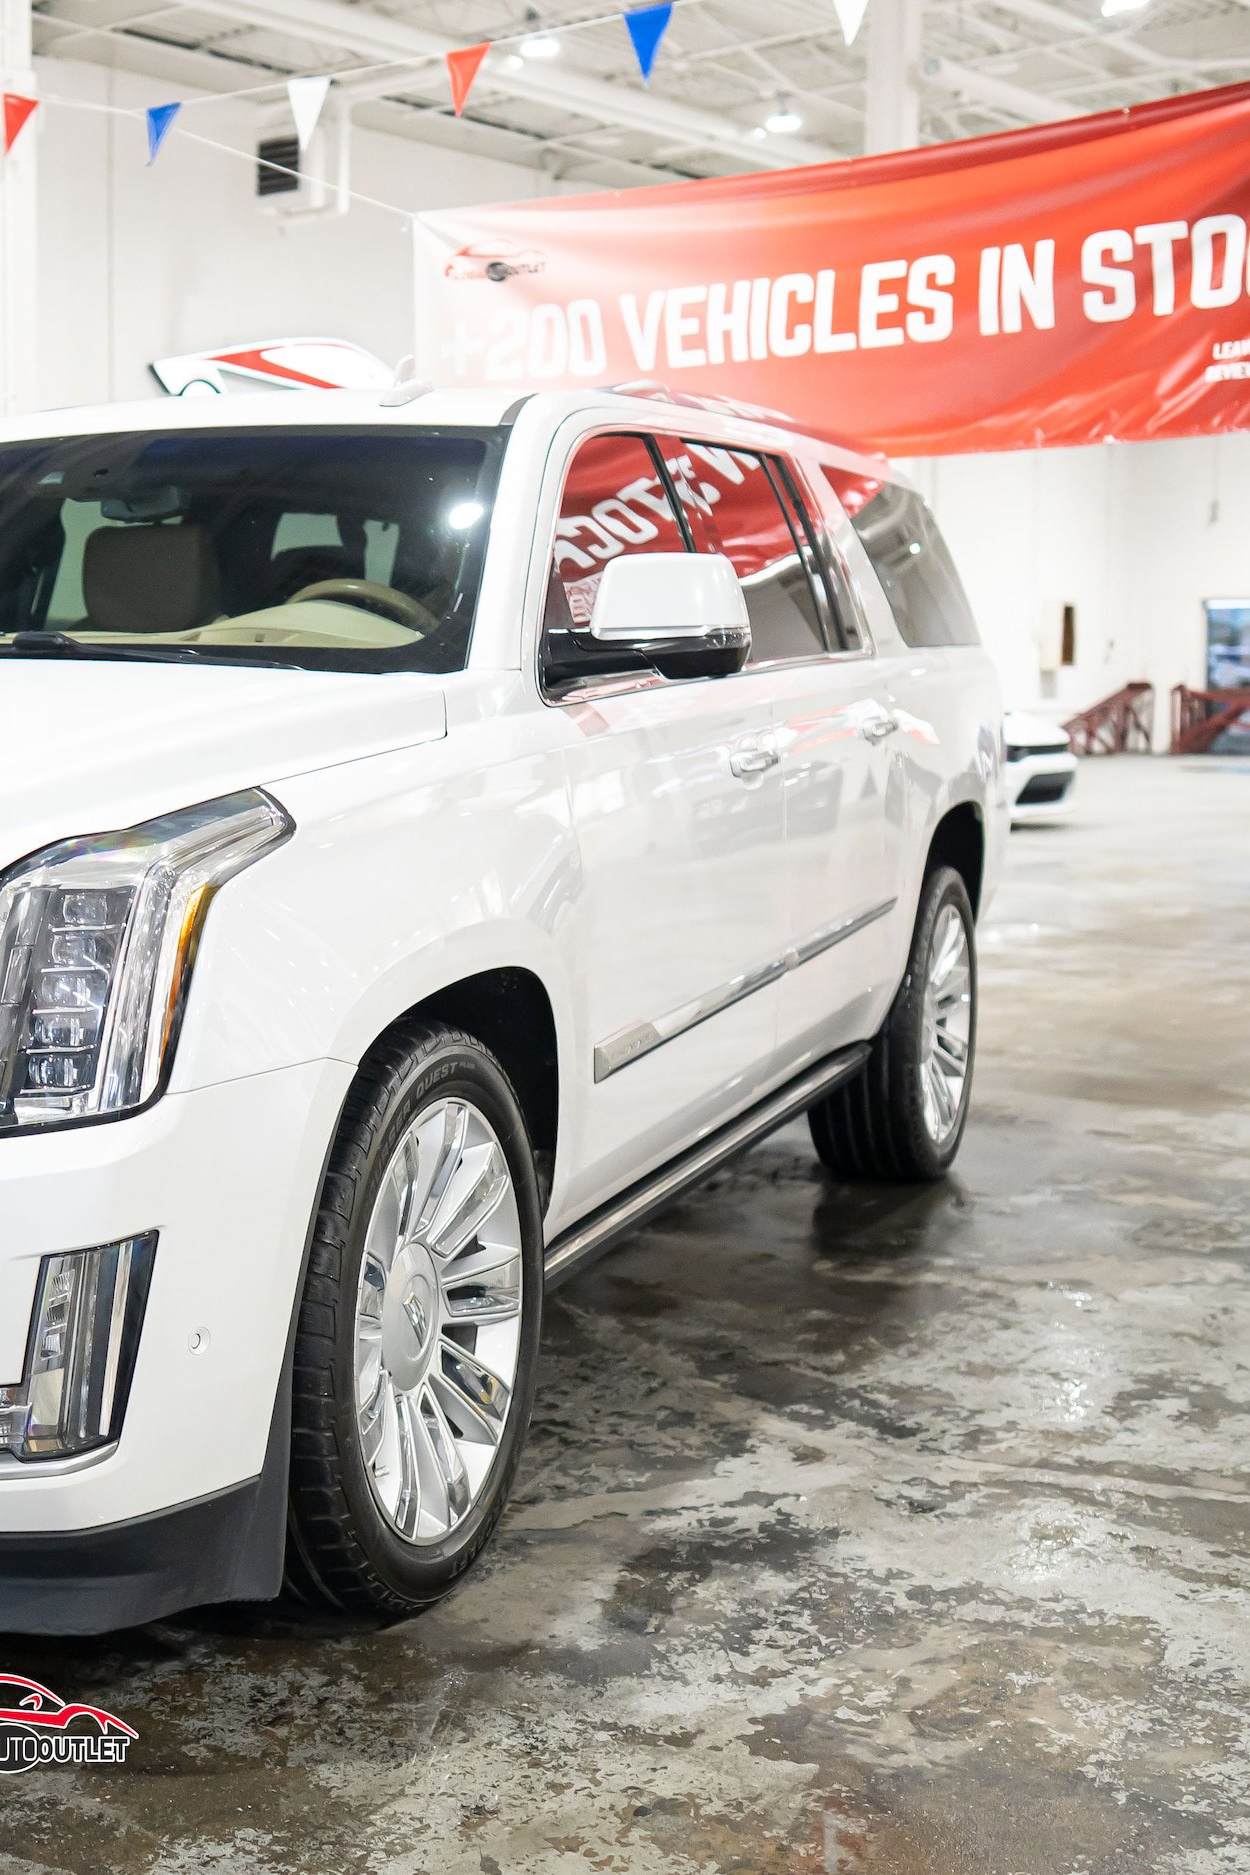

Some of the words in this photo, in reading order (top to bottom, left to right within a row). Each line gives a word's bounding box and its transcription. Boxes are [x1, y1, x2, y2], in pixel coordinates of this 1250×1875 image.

[618, 254, 956, 371] VEHICLES
[979, 238, 1055, 336] IN
[1081, 214, 1250, 323] STO
[416, 1062, 459, 1099] QUEST
